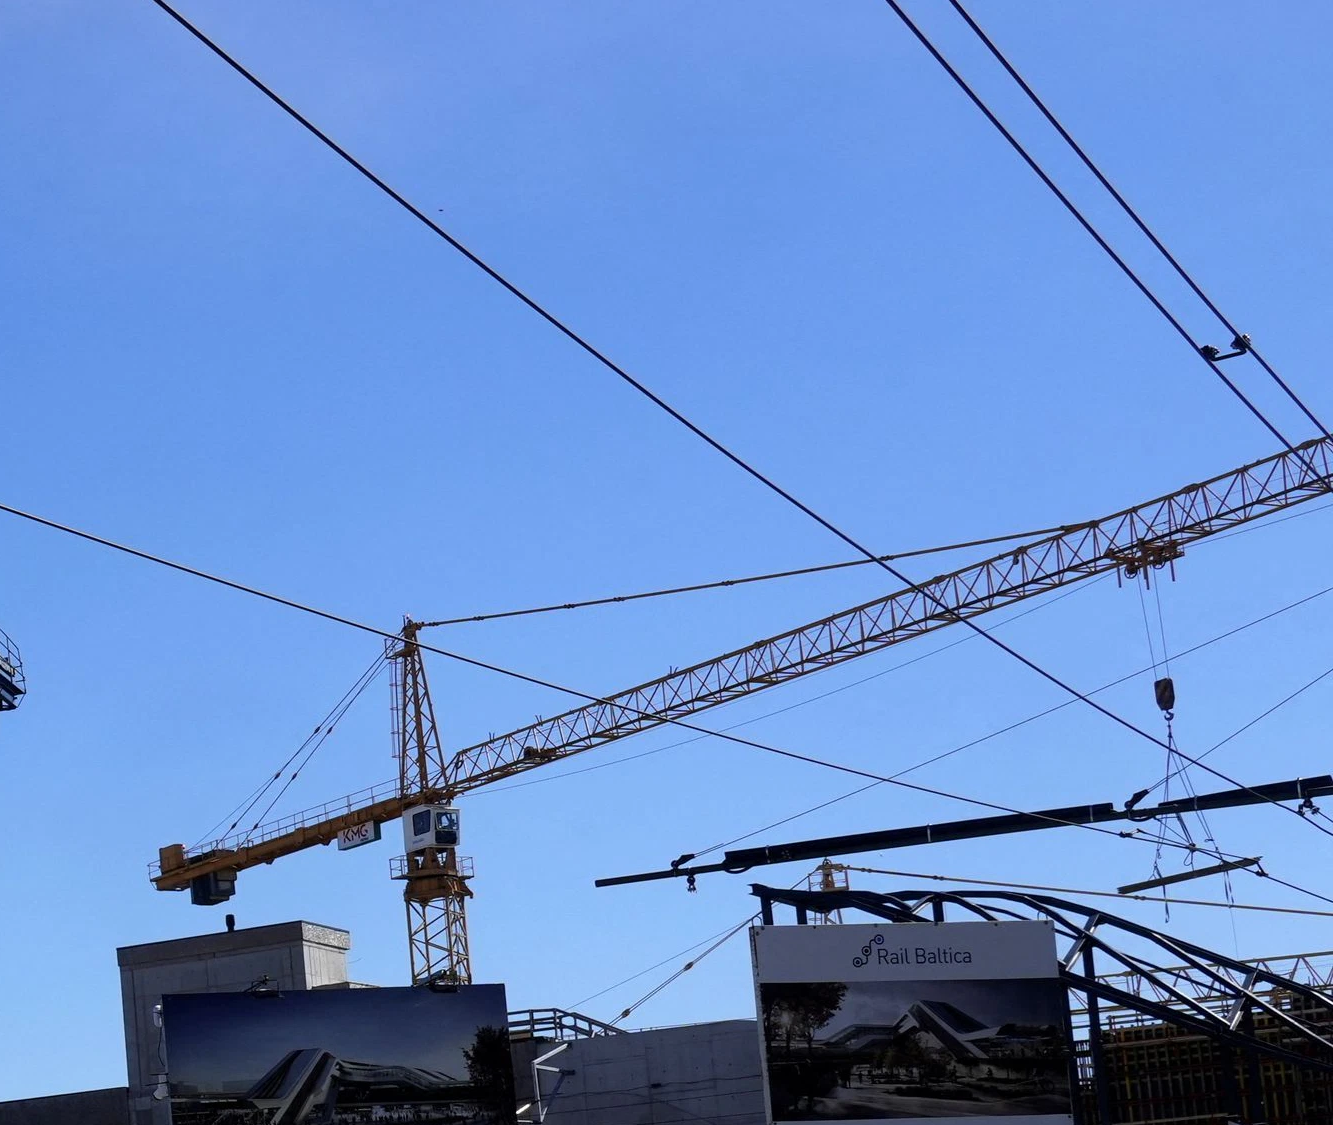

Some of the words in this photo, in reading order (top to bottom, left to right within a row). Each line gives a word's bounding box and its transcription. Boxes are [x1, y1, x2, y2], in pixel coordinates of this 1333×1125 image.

[342, 824, 369, 843] KMG
[877, 948, 911, 966] Rail
[914, 946, 972, 965] Baltica
